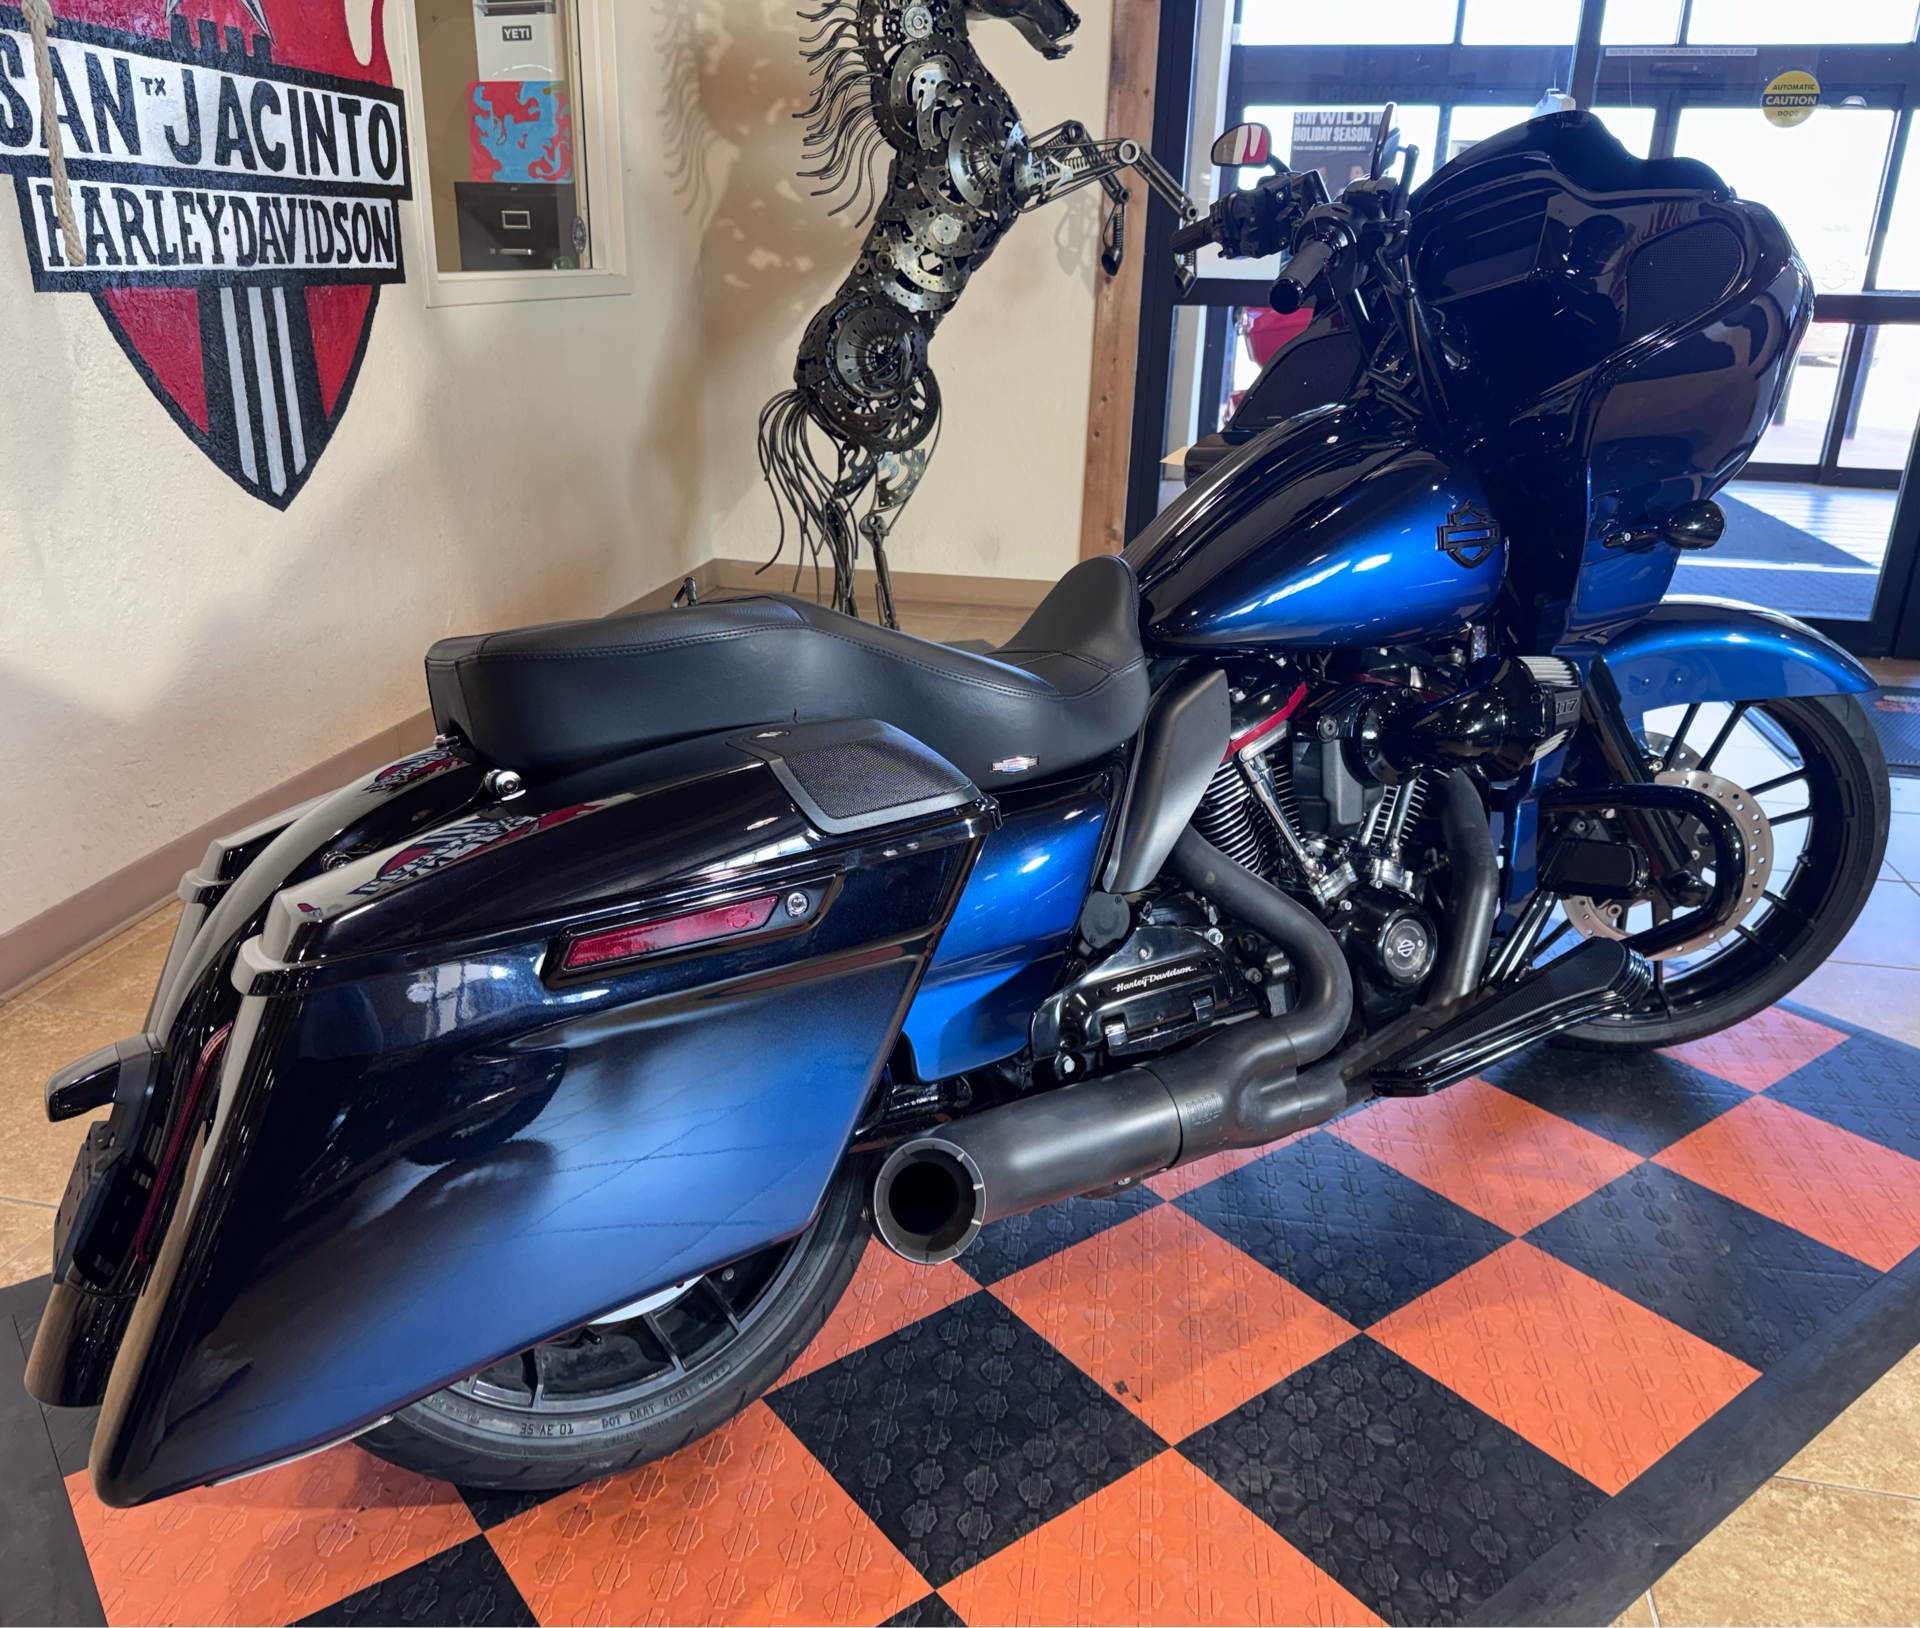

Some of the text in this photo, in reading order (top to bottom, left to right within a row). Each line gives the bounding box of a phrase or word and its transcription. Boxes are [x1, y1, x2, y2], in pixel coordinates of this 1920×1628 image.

[503, 28, 530, 39] YETI
[140, 77, 167, 97] TX
[0, 33, 398, 181] SAN JACINTO
[1765, 95, 1817, 106] CAUTION
[1295, 112, 1319, 125] STAY
[1319, 112, 1366, 125] WILD
[1293, 127, 1373, 142] HOLIDAY SEASON.
[1556, 698, 1579, 716] 117
[1111, 965, 1198, 993] Harley-Davidson
[539, 1424, 554, 1436] AE
[602, 1415, 622, 1429] DOT
